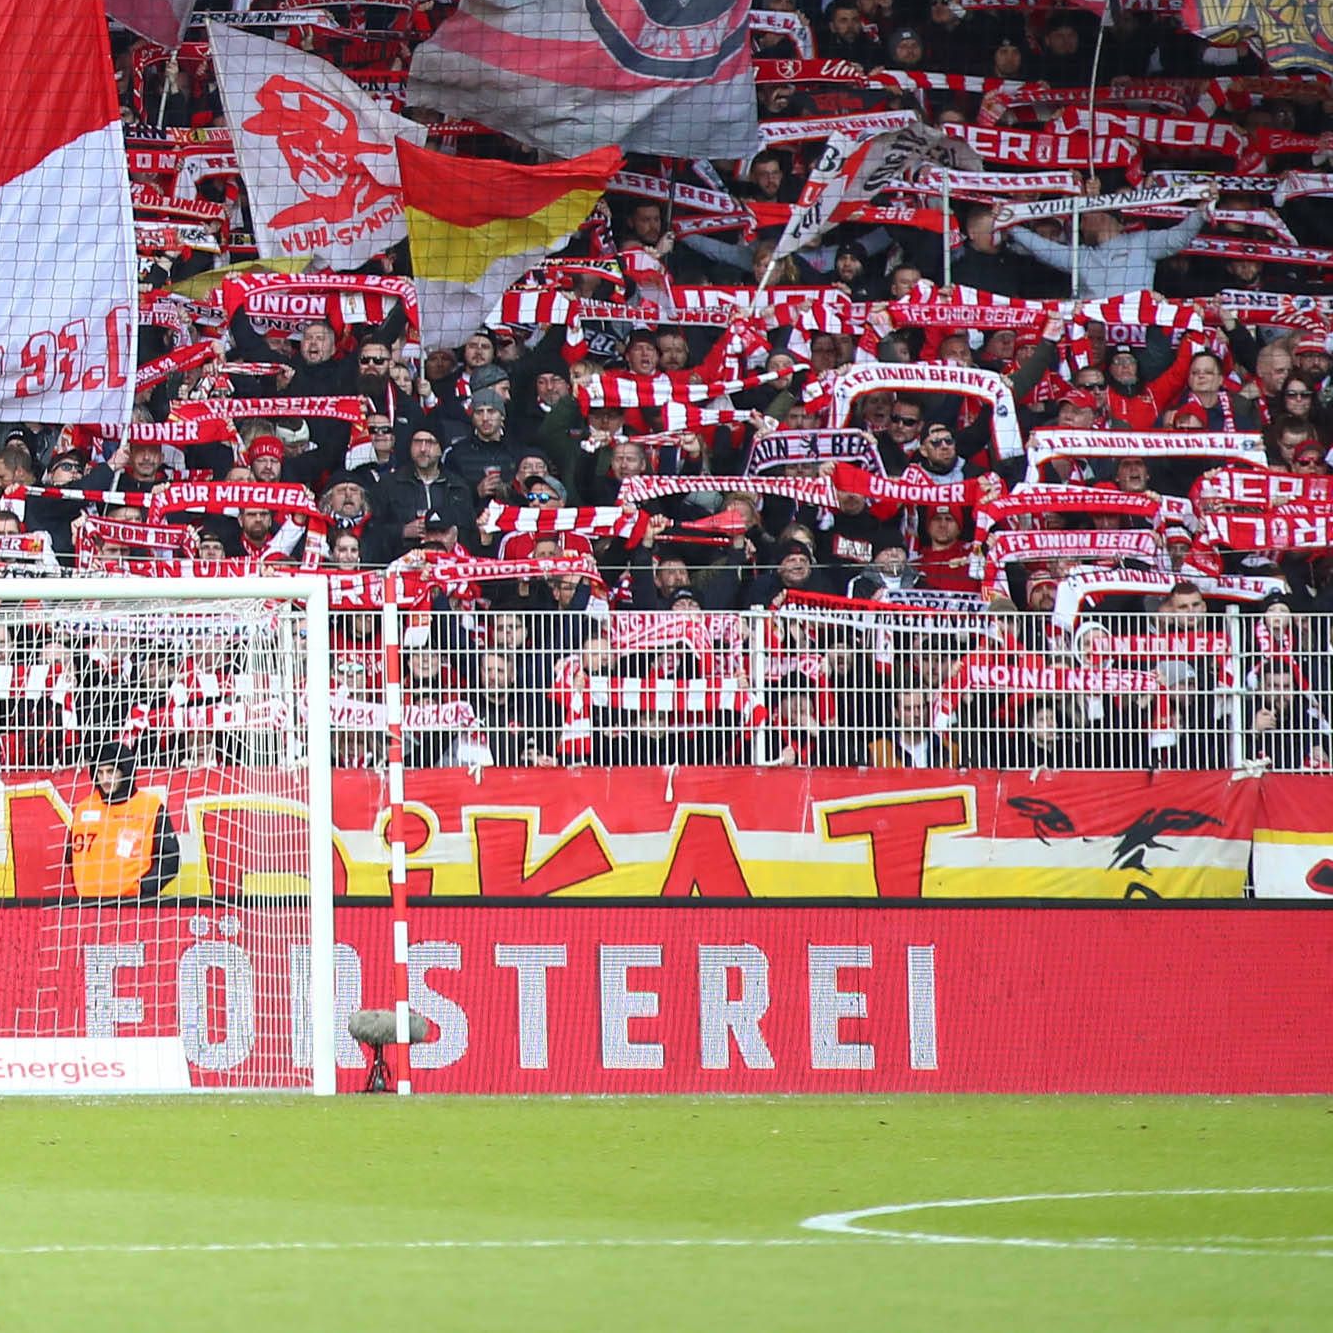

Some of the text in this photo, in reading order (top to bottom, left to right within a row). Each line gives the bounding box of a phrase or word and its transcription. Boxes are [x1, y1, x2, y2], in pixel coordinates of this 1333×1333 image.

[248, 293, 327, 316] UNION
[937, 306, 1037, 324] UNION BERLIN
[875, 367, 985, 387] UNION BERLIN
[206, 396, 339, 414] WALDSEITE
[1081, 436, 1133, 454] UNION
[1135, 436, 1200, 453] BERLIN
[171, 482, 212, 506] FÜR
[869, 478, 967, 503] UNIONER
[1006, 534, 1030, 551] FC
[1034, 532, 1091, 550] UNION
[84, 915, 939, 1071] FÖRSTEREI
